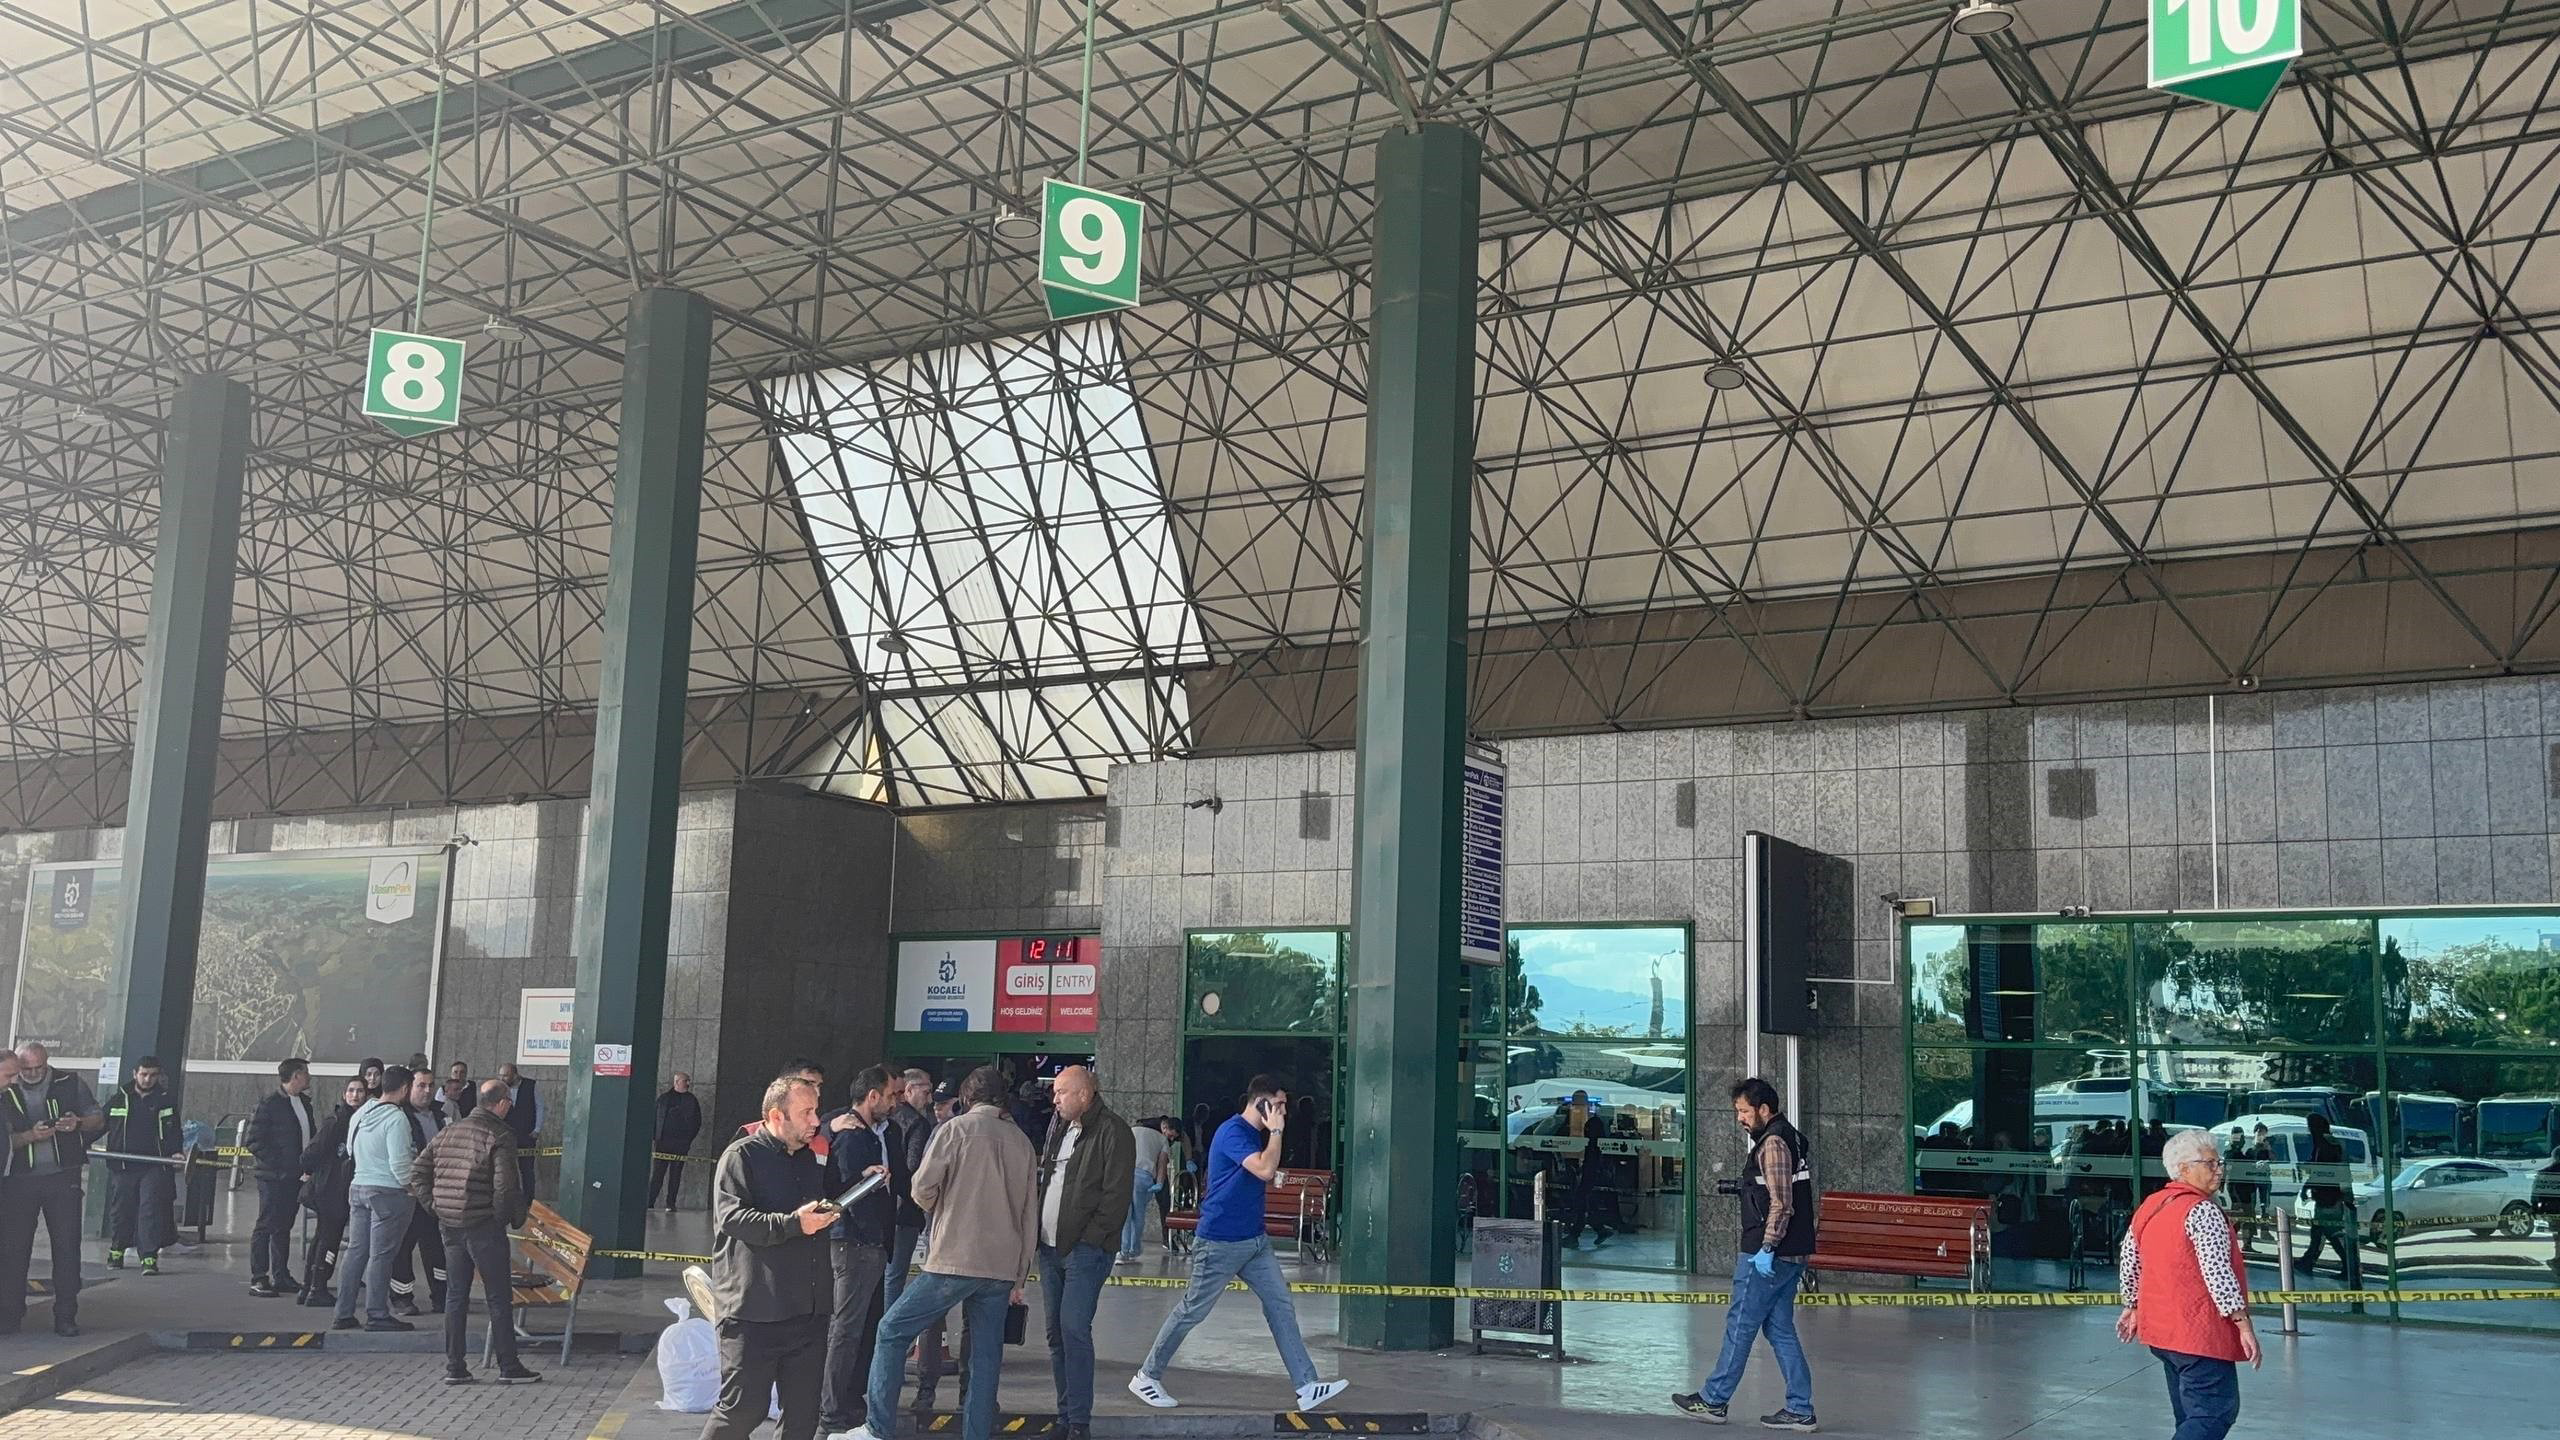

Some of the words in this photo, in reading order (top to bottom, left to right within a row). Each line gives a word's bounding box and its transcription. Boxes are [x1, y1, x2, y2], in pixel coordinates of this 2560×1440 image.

[2167, 0, 2279, 64] 10
[1059, 197, 1126, 285] 9
[381, 341, 445, 412] 8
[1030, 940, 1046, 959] 12
[1056, 941, 1072, 958] 11
[927, 984, 966, 995] KOCAELİ
[1014, 973, 1045, 991] GİRİŞ
[1056, 975, 1093, 988] ENTRY
[1000, 1007, 1014, 1017] HOŞ
[1060, 1007, 1094, 1016] WELCOME
